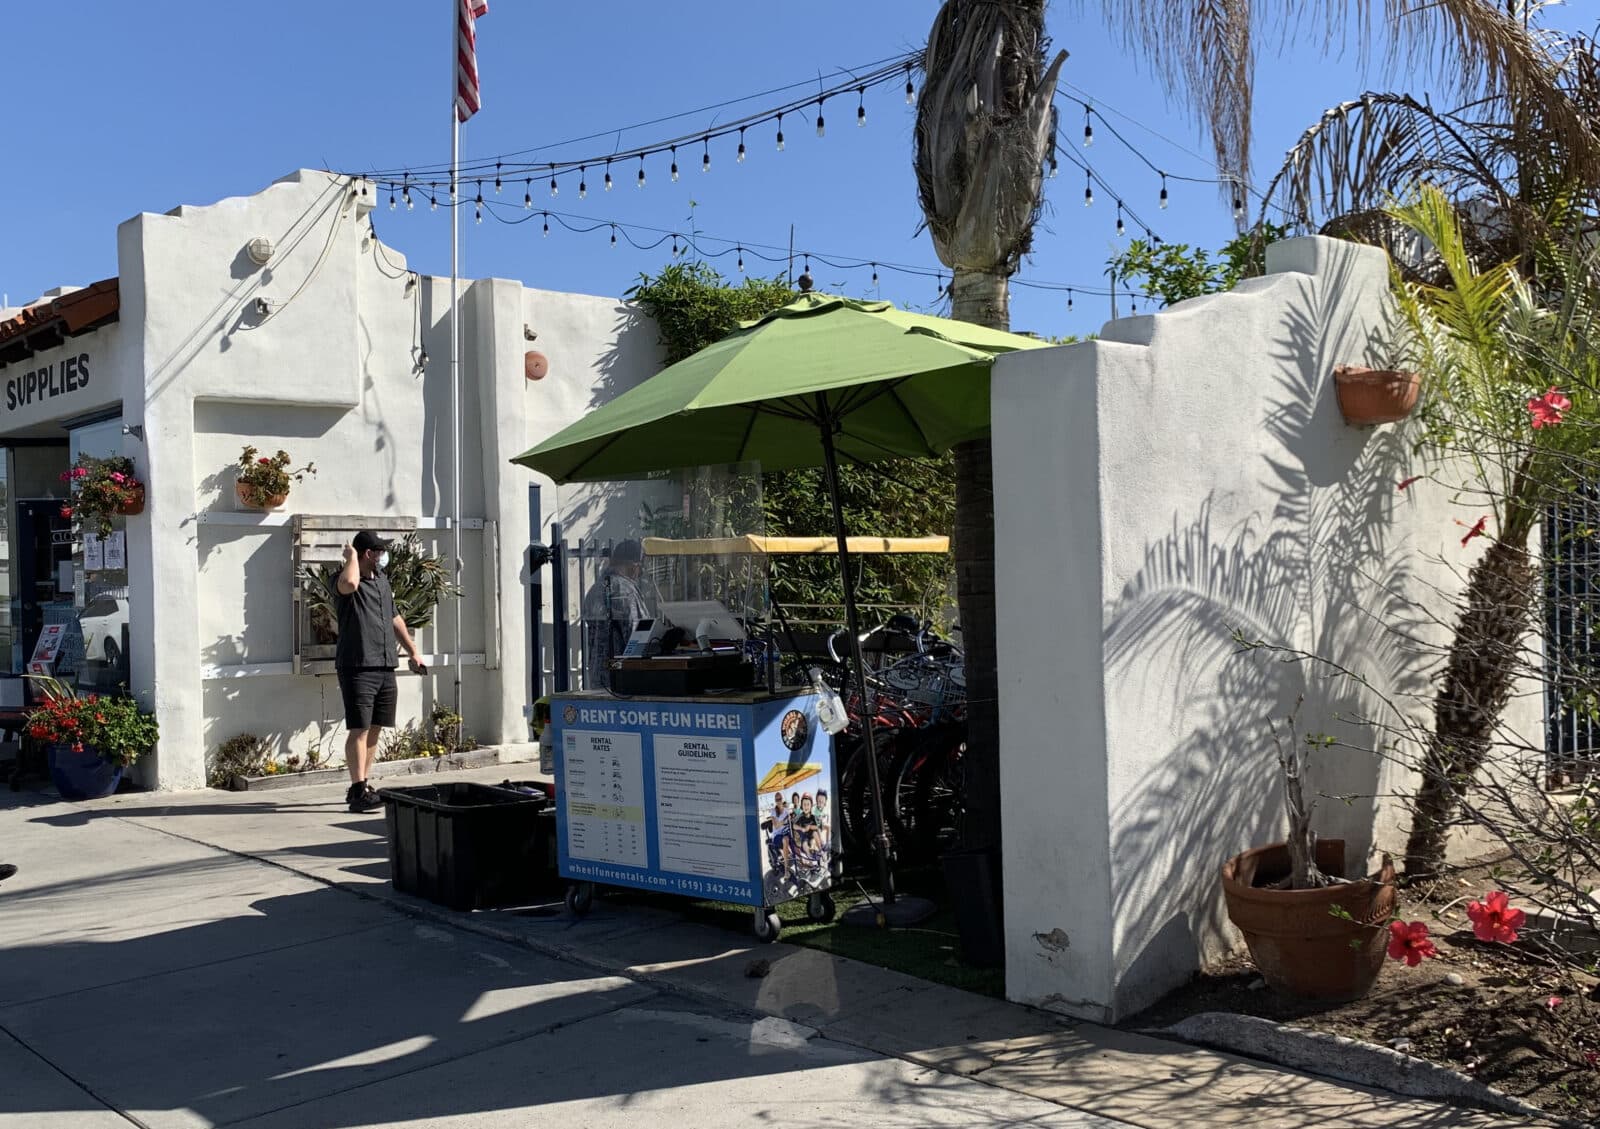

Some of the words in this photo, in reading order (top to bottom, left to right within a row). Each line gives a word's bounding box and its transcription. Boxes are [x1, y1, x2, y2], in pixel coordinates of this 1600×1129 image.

[7, 353, 90, 411] SUPPLIES
[580, 709, 617, 724] RENT
[620, 711, 658, 726] SOME
[661, 712, 691, 727] FUN
[695, 714, 741, 729] HERE!
[590, 736, 612, 745] RENTAL
[592, 744, 610, 752] RATES
[683, 742, 710, 751] RENTAL
[677, 749, 717, 759] GUIDELINES
[569, 863, 667, 886] wheelfunrentals.com
[677, 879, 703, 893] (619)
[706, 883, 752, 898] 342-7244
